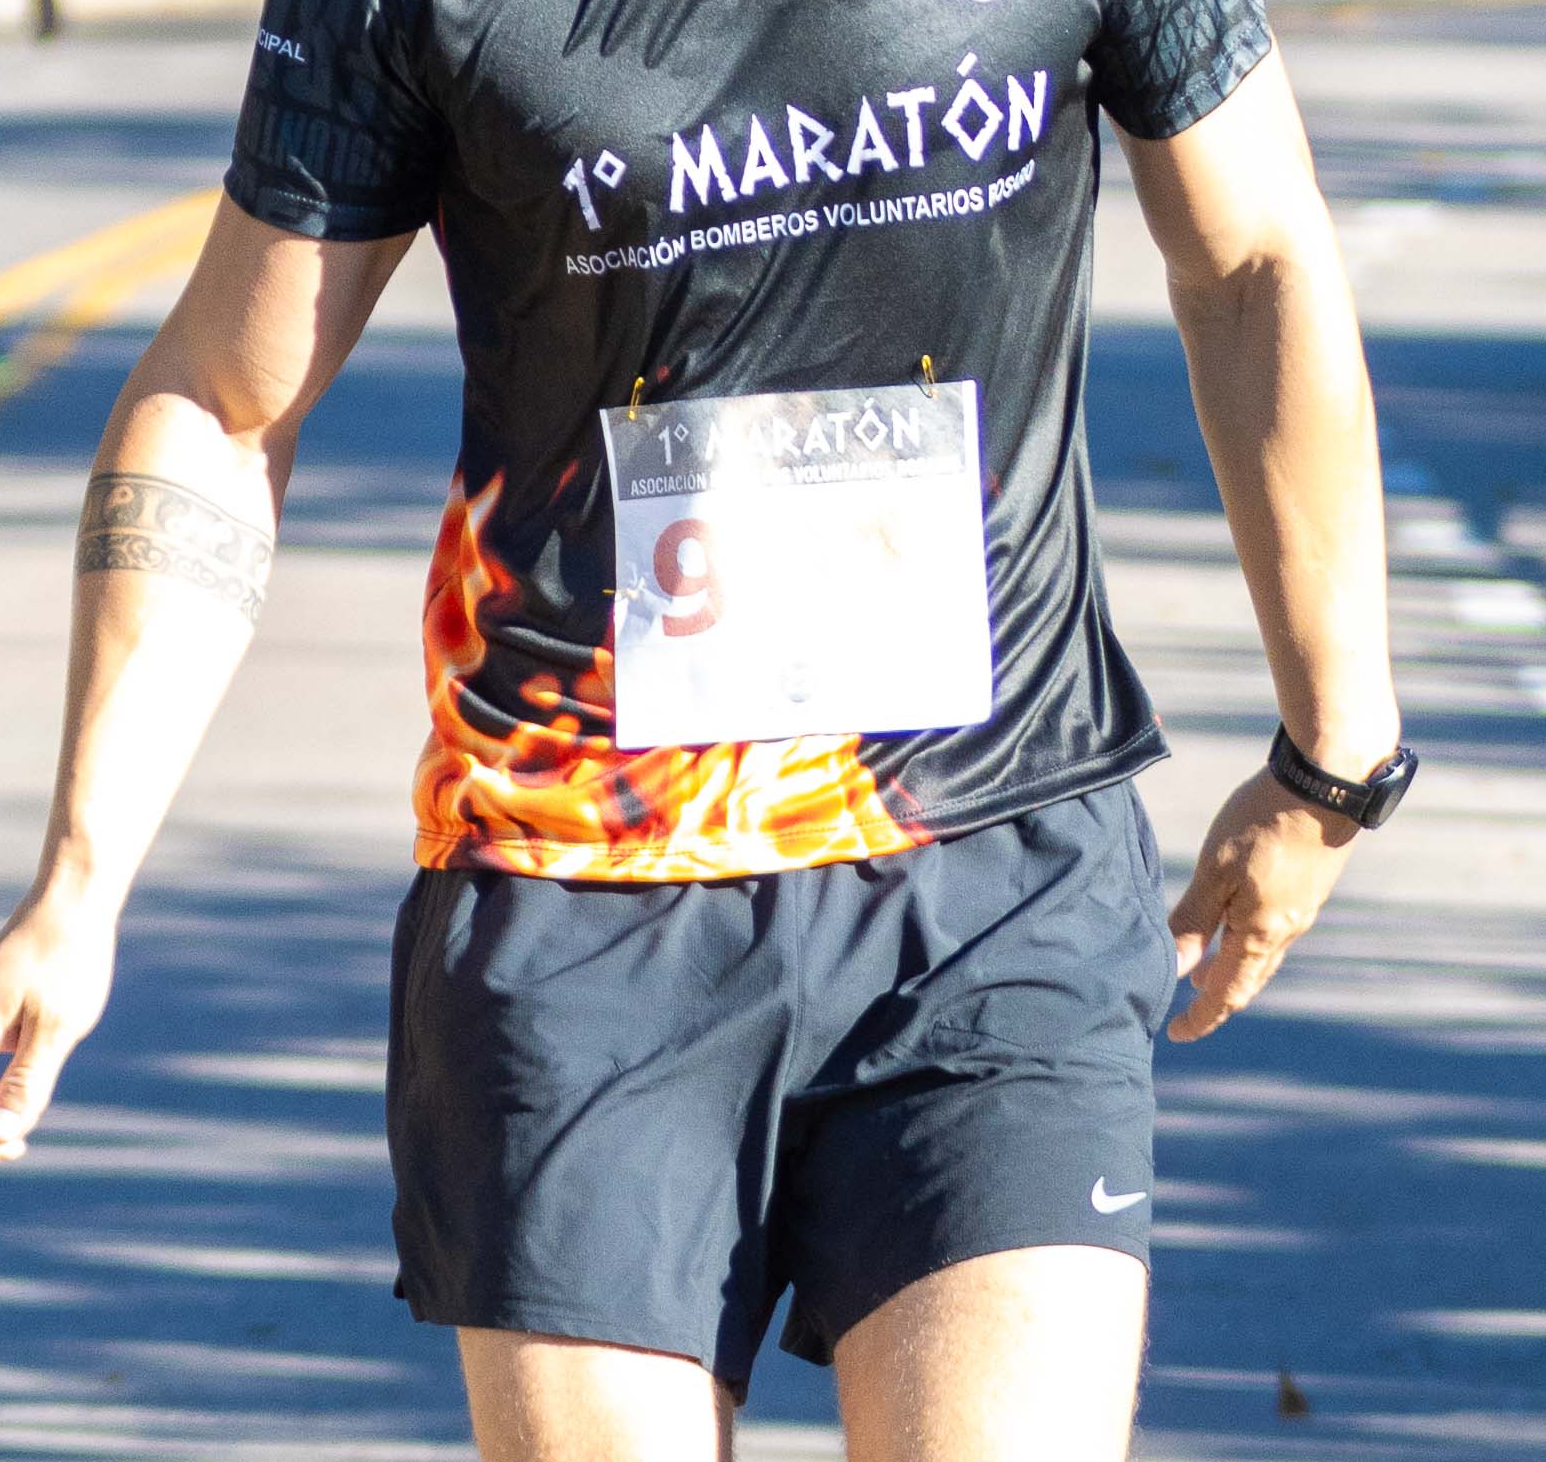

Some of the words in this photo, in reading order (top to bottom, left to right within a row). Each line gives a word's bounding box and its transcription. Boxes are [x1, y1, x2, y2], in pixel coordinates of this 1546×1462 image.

[669, 52, 1048, 213] MARATÓN
[566, 235, 686, 275] ASOCIACIÓN
[690, 210, 820, 250] BOMBEROS
[823, 186, 985, 227] VOLUNTARIOS
[630, 471, 707, 496] ASOCIACIÓN
